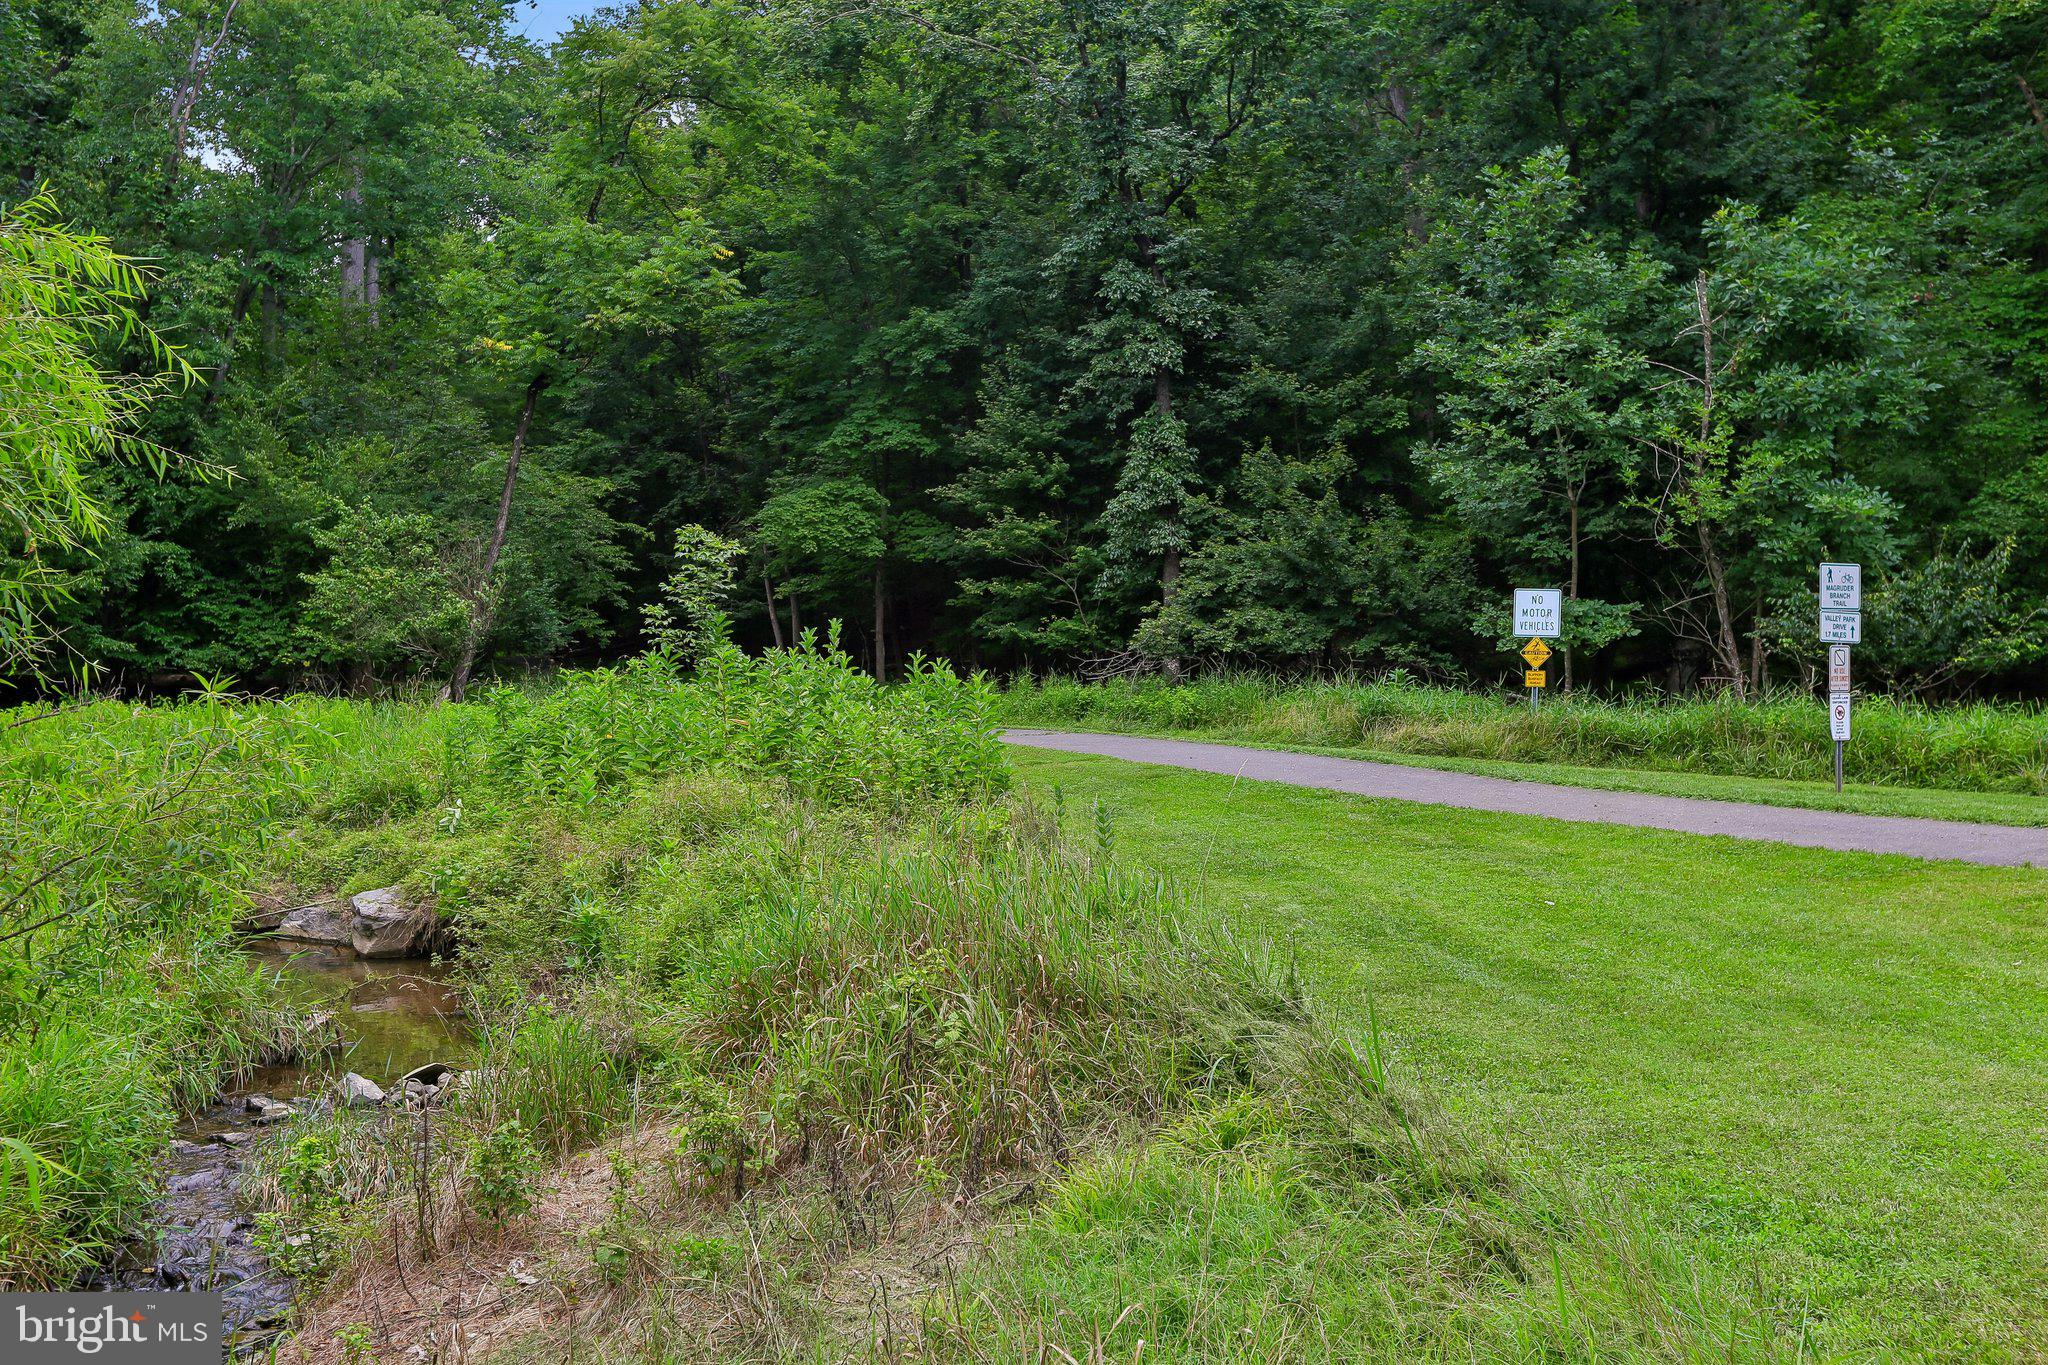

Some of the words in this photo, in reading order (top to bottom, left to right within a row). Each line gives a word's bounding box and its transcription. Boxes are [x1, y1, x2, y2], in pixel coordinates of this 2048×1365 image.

[1532, 596, 1544, 604] NO
[1522, 608, 1552, 618] MOTOR
[1520, 622, 1554, 631] VEHICLES
